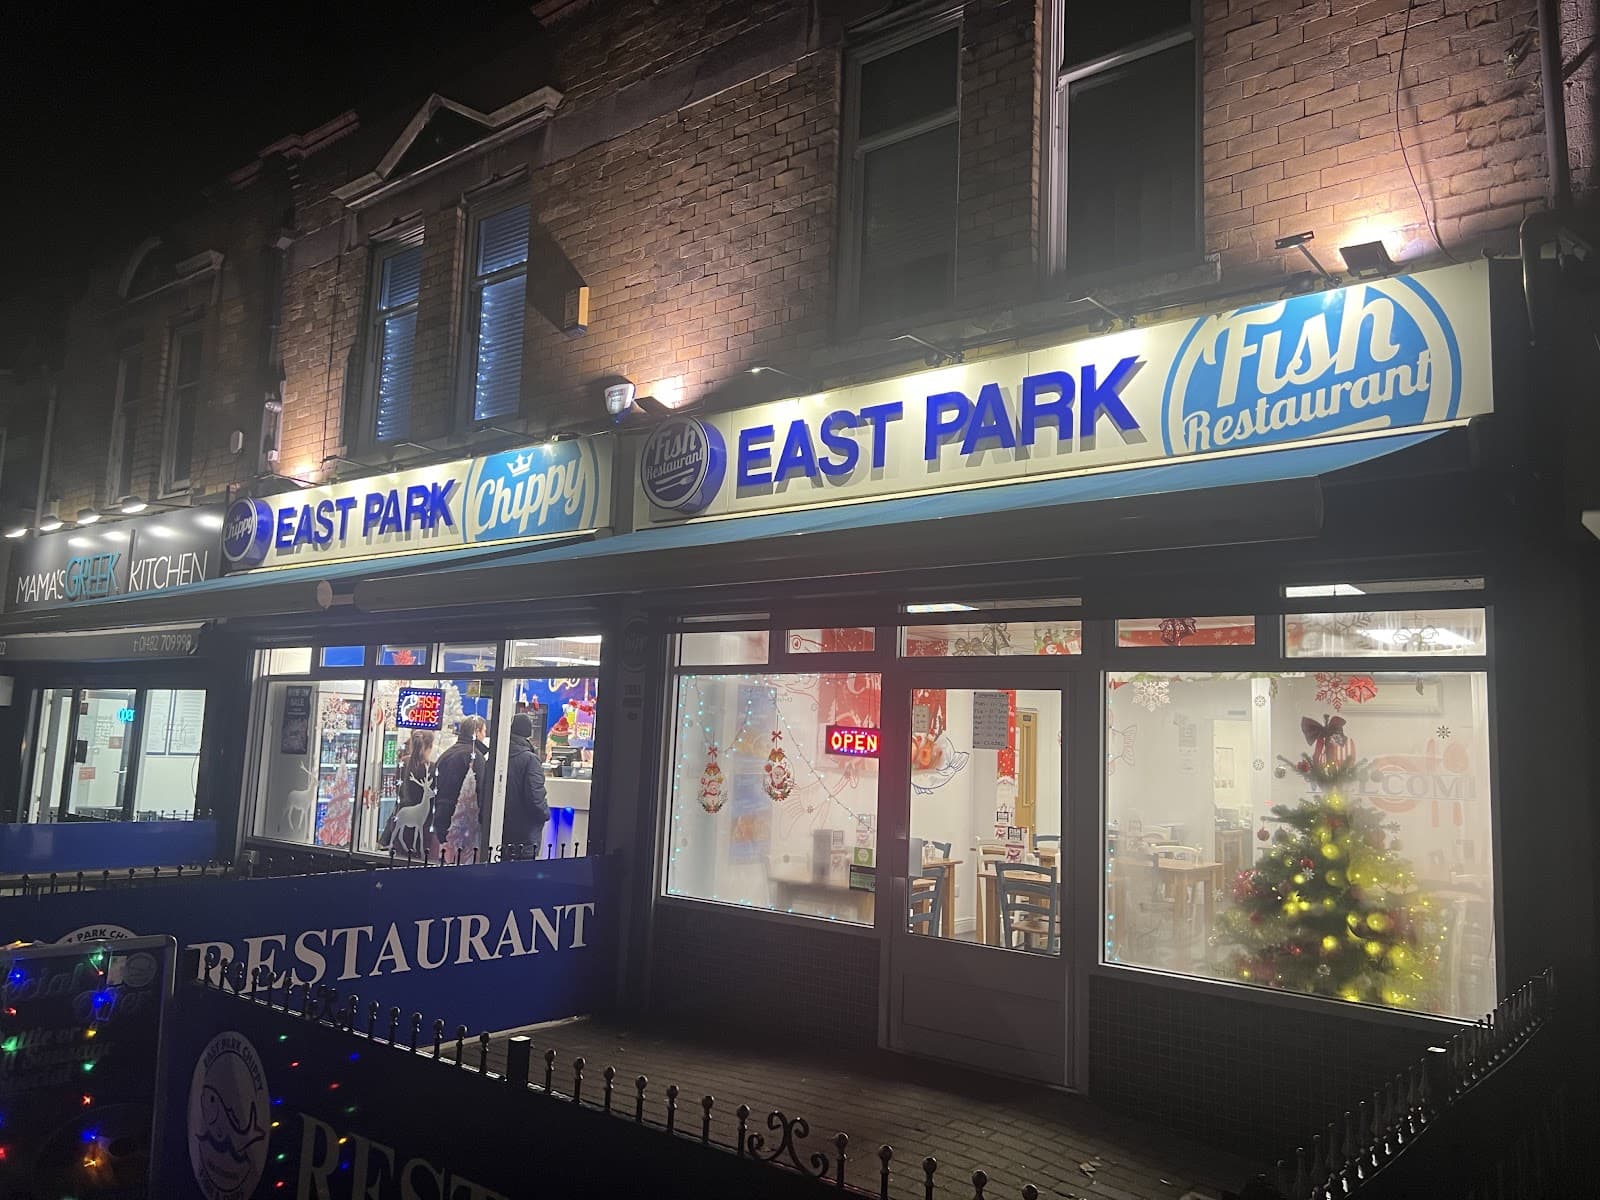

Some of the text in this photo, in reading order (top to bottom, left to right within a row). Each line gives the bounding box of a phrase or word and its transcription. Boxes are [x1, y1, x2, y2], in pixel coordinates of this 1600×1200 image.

[1202, 286, 1400, 408] Fish
[737, 356, 1140, 488] EAST PARK
[1184, 349, 1432, 453] Restaurant
[647, 448, 703, 481] Restaurant
[648, 422, 697, 466] Fish
[275, 478, 457, 549] EAST PARK
[474, 459, 583, 535] Chippy
[16, 550, 209, 603] MAMA'S GREEK KITCHEN
[408, 709, 437, 723] CHIPS
[417, 695, 440, 709] FISH
[831, 731, 878, 752] OPEN
[76, 928, 107, 941] PARK
[186, 902, 596, 993] RESTAURANT
